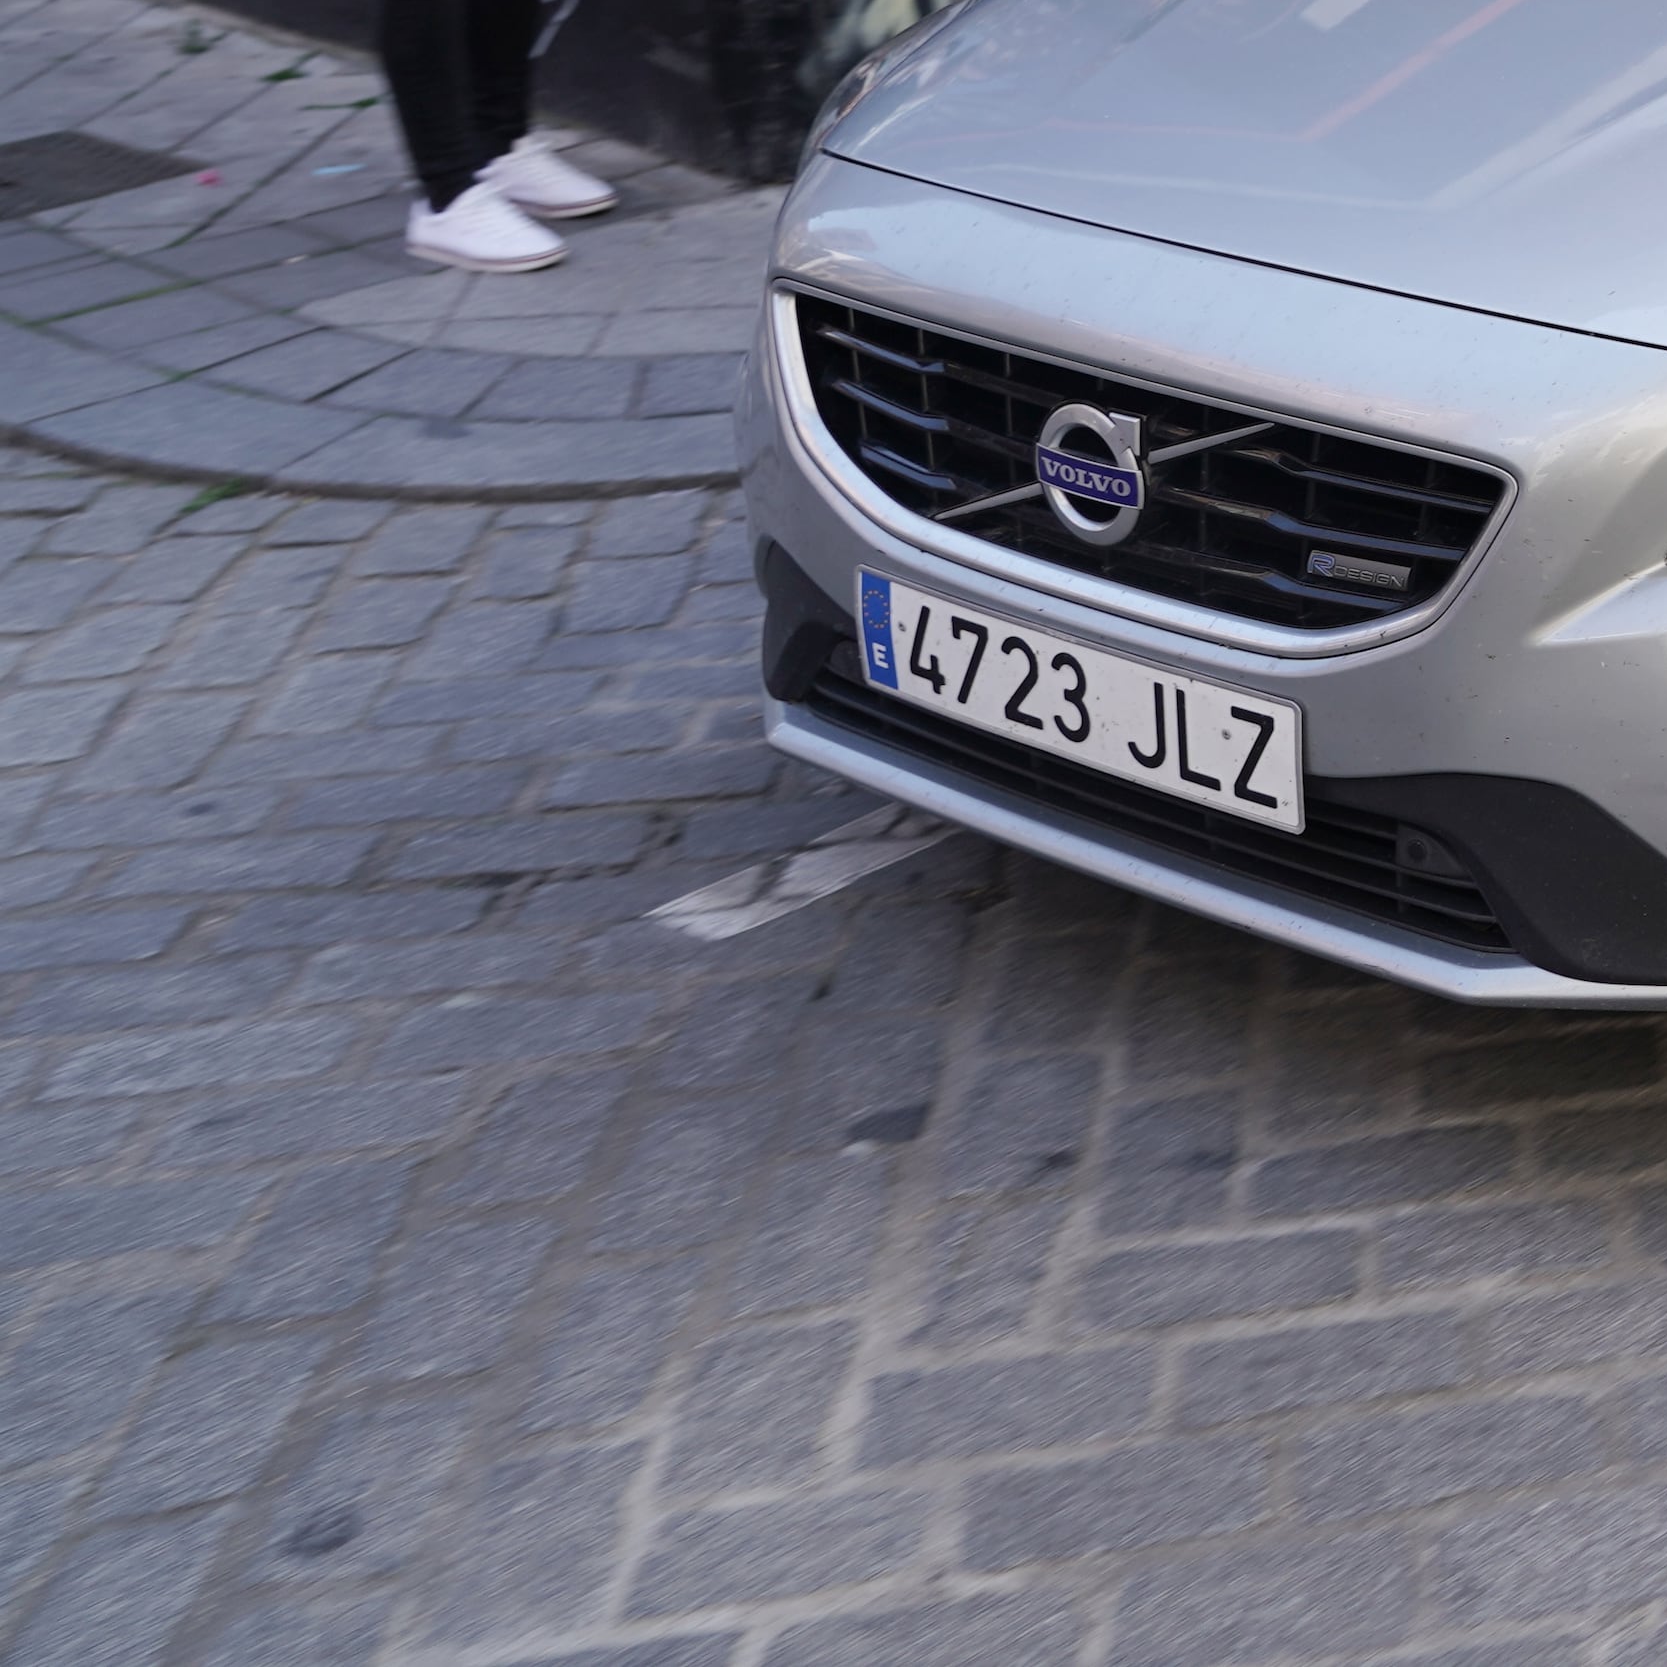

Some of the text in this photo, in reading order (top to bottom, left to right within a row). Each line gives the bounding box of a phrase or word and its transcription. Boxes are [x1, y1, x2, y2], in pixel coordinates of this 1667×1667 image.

[1040, 456, 1132, 498] VOLVO
[872, 642, 889, 670] E
[909, 605, 1279, 810] 4723 JLZ
